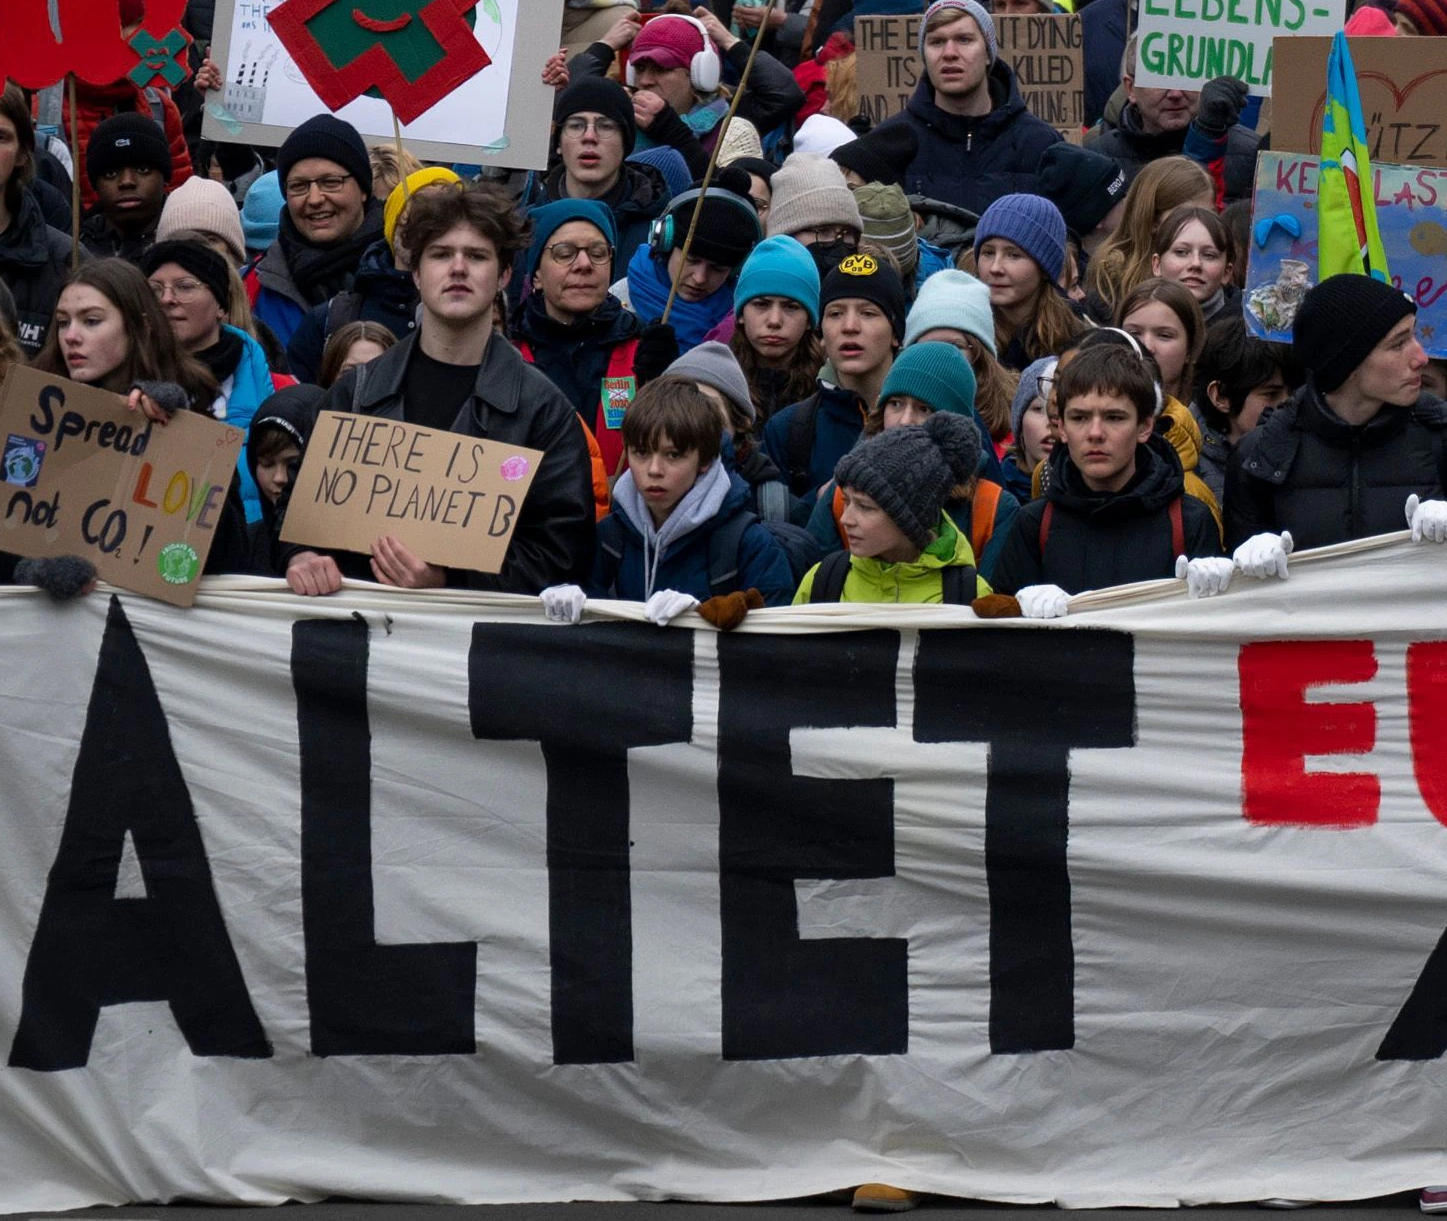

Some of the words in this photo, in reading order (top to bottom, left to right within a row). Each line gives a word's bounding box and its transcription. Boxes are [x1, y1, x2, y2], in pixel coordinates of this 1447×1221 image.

[859, 17, 897, 51] THE
[1027, 17, 1082, 49] DYING
[887, 56, 916, 88] ITS
[1012, 55, 1073, 85] KILLED
[844, 255, 873, 270] BVB
[30, 385, 153, 456] Spread
[328, 416, 431, 473] THERE
[445, 442, 484, 483] IS
[6, 491, 60, 528] not
[132, 462, 224, 529] LOVE
[315, 466, 358, 506] NO
[366, 474, 486, 528] PLANET
[488, 494, 516, 537] B
[163, 572, 189, 584] FUTURE
[9, 596, 1138, 1073] ALTET
